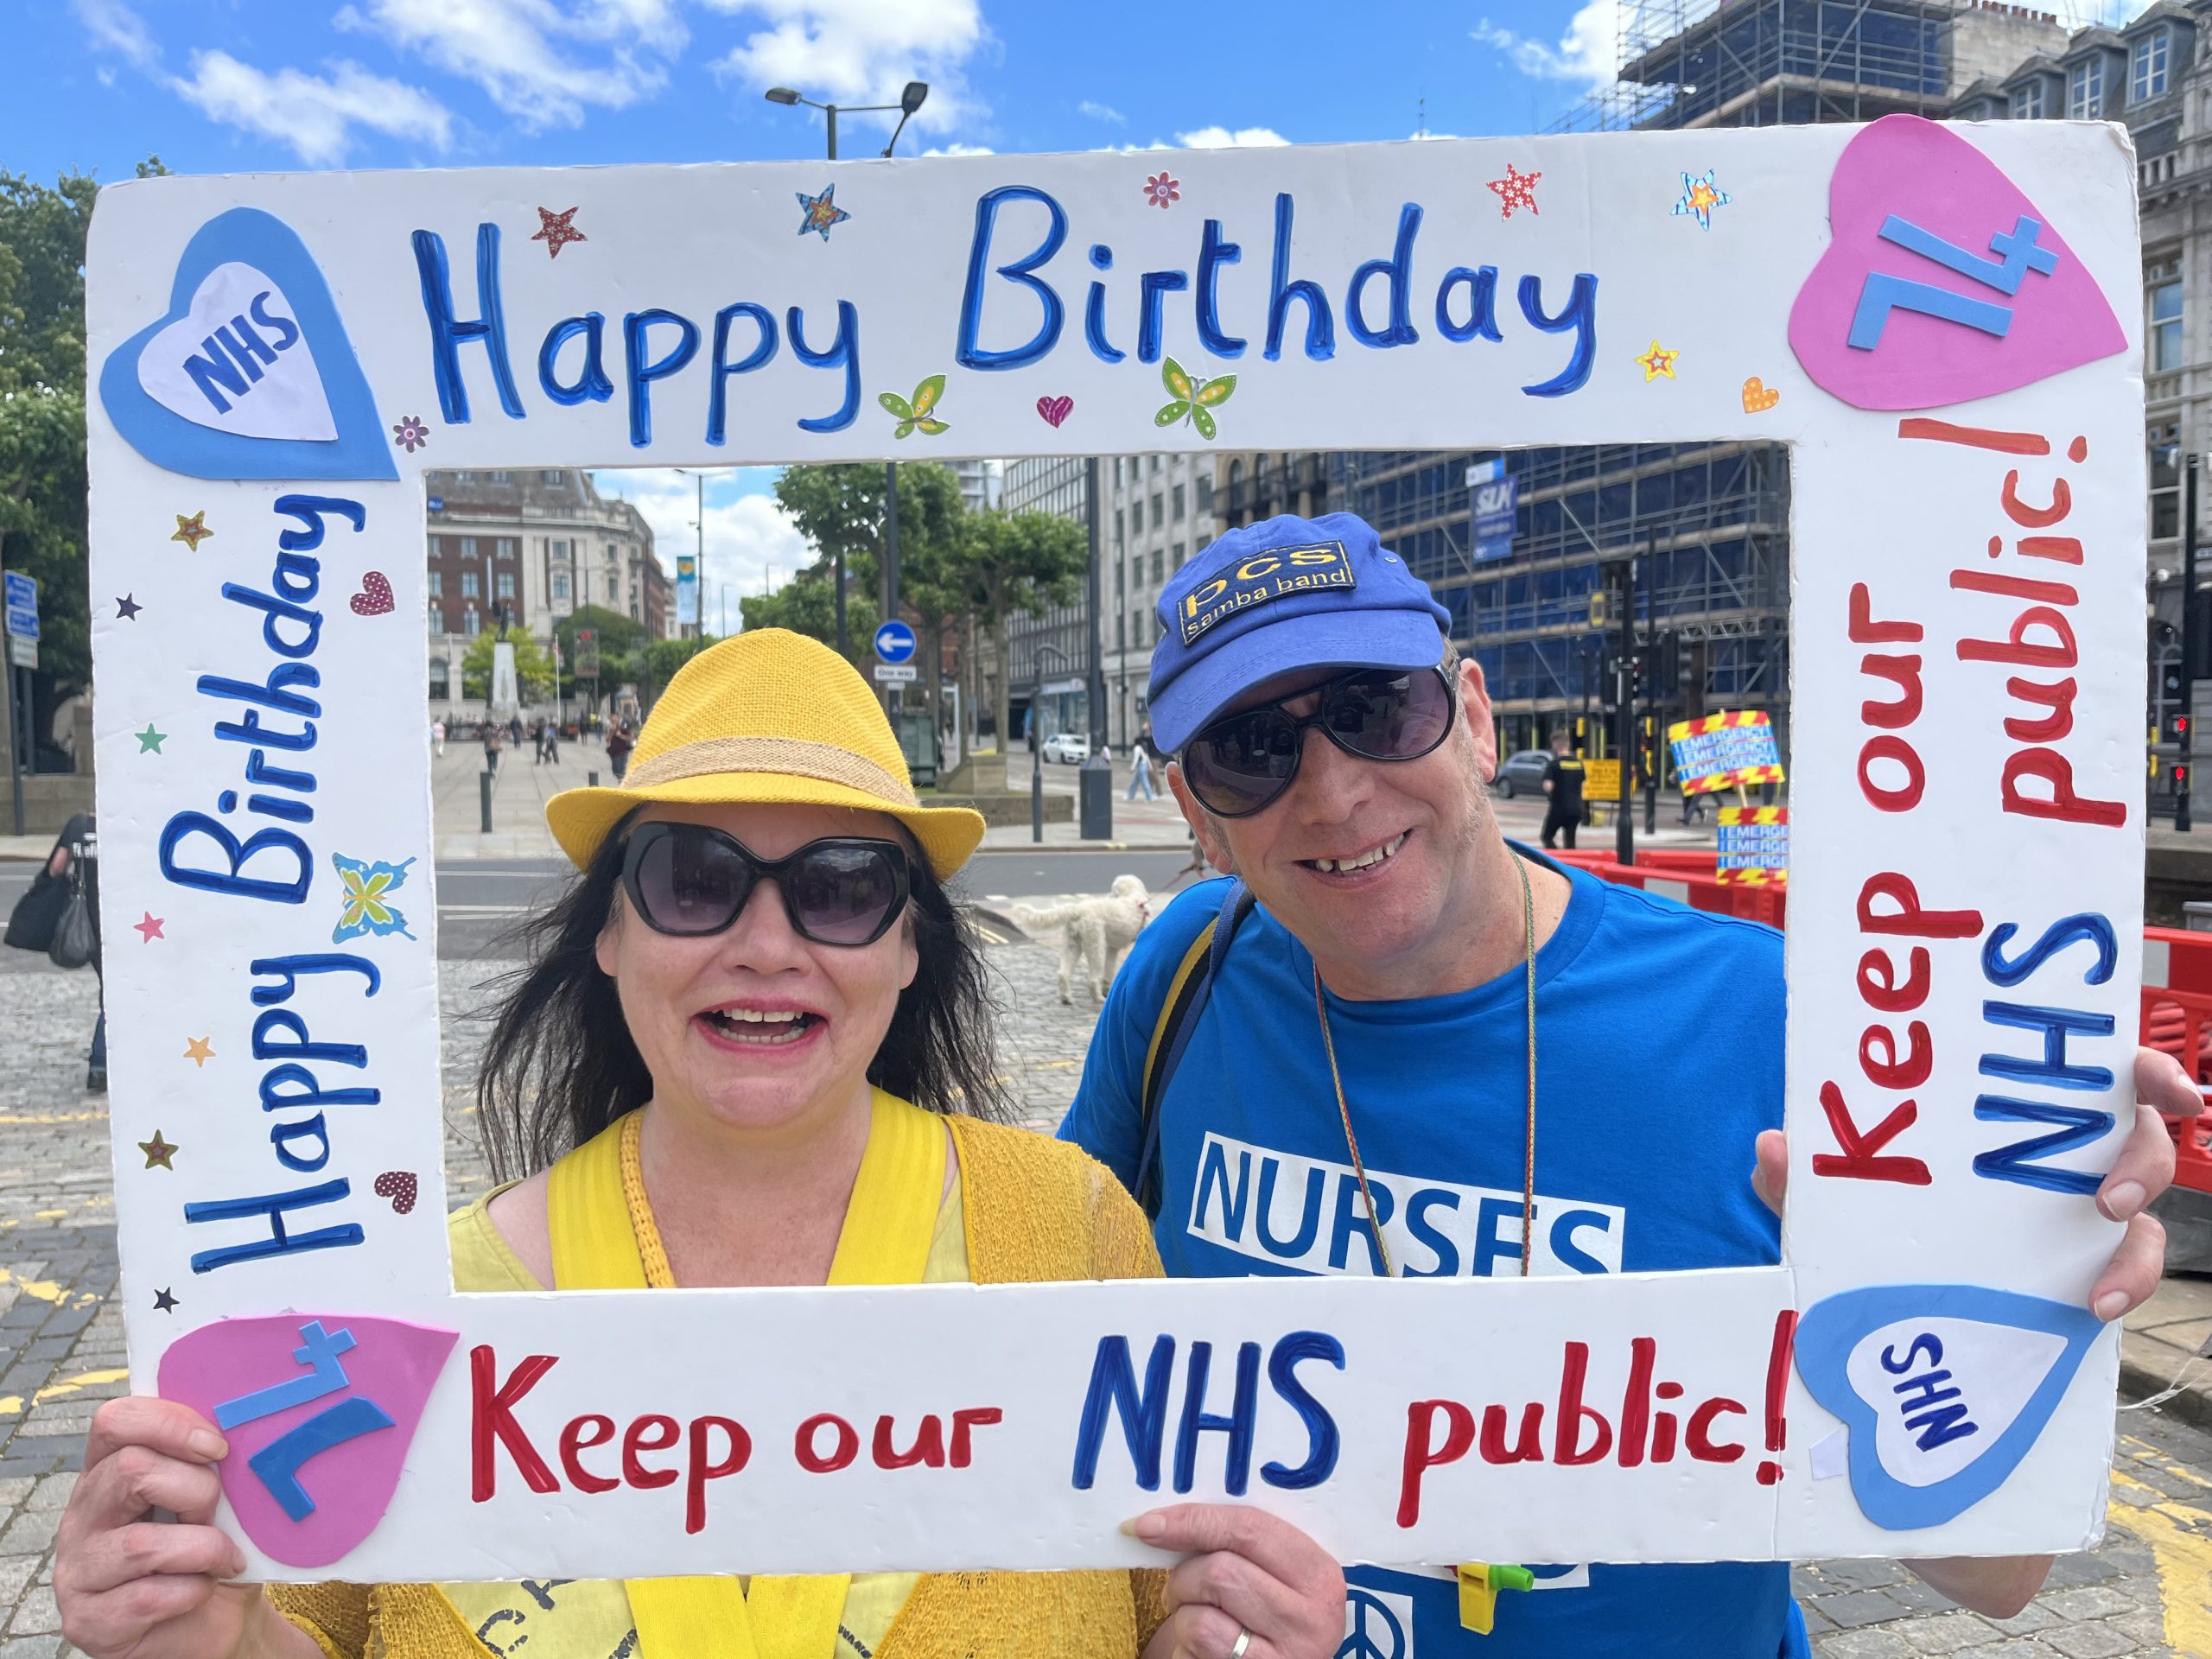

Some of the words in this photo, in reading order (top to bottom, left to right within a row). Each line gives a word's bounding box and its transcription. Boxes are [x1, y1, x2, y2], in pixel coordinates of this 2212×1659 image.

[182, 290, 299, 415] NHS
[411, 221, 861, 449] Happy
[955, 184, 1599, 399] Birthday
[1847, 213, 2059, 351] 74
[1185, 549, 1338, 618] pcs
[1187, 586, 1268, 635] samba
[1276, 568, 1347, 592] band
[1898, 418, 2127, 829] public!
[157, 493, 367, 906] Birthday
[1848, 582, 1926, 814] our
[183, 952, 382, 1273] Happy
[1813, 872, 1985, 1186] Keep
[1972, 912, 2118, 1196] NHS
[1193, 1140, 1611, 1277] NURSES
[213, 1319, 397, 1523] 74
[470, 1344, 753, 1535] Keep
[794, 1407, 1003, 1473] our
[1071, 1329, 1347, 1497] NHS
[1396, 1310, 1799, 1529] public!
[1880, 1332, 1979, 1452] NHS
